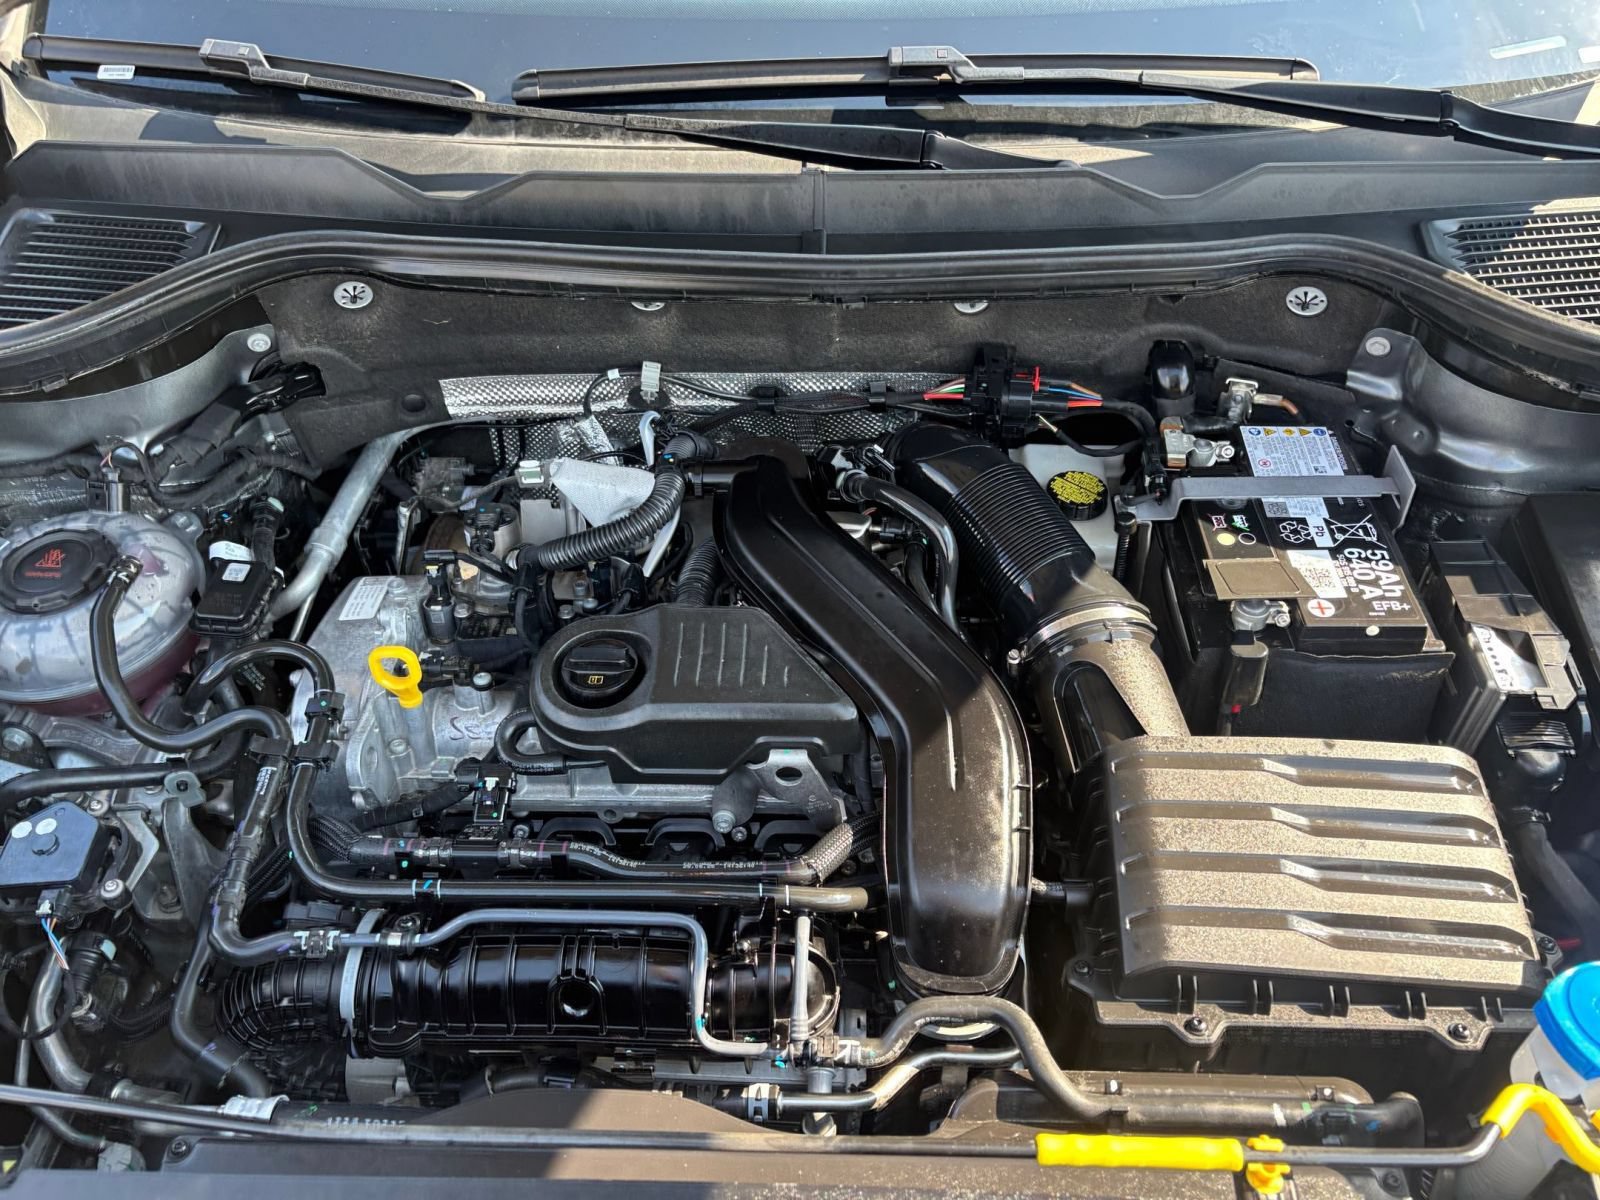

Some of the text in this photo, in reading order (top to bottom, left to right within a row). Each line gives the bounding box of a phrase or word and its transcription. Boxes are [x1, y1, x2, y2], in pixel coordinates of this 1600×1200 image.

[1313, 525, 1324, 537] Pb
[1344, 548, 1375, 582] 640
[1366, 550, 1404, 598] 59Ah
[1359, 584, 1383, 600] A
[1372, 601, 1411, 611] EFB+
